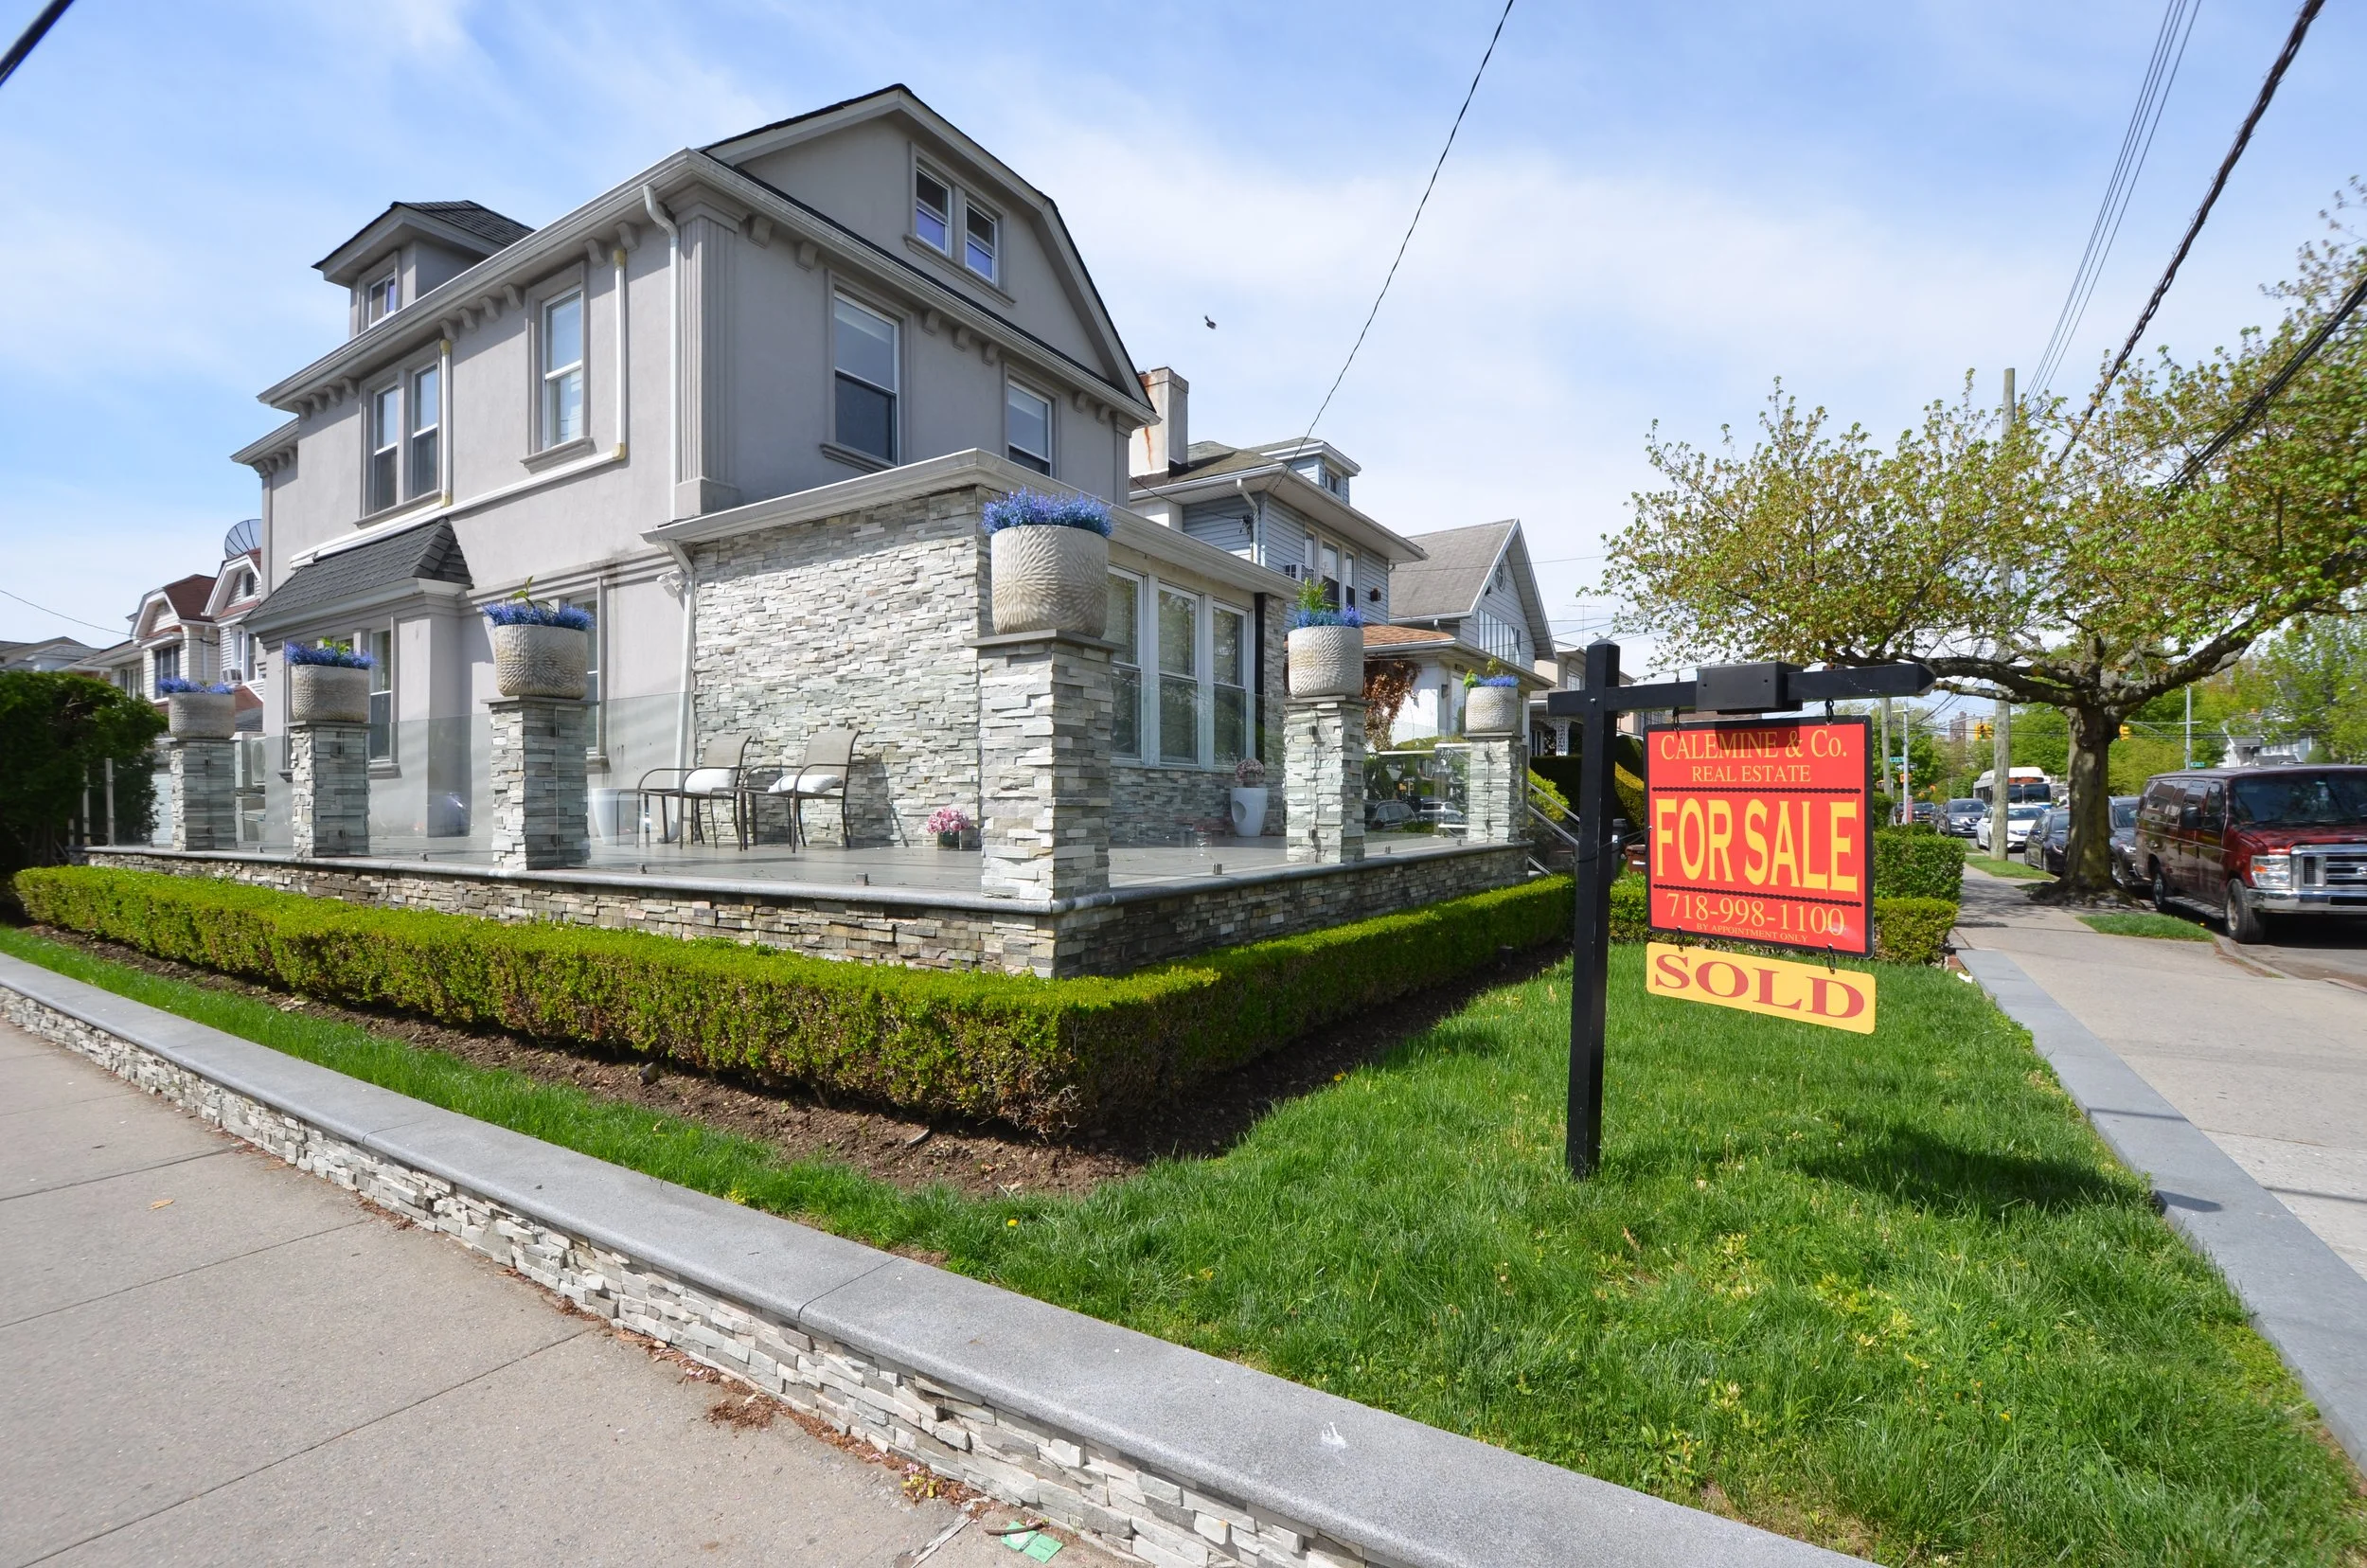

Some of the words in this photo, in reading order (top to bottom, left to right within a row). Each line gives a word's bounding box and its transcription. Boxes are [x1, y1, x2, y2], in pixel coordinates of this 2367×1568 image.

[1661, 731, 1779, 760] CALEMINE
[1785, 730, 1804, 758] &
[1810, 728, 1847, 757] Co.
[1692, 765, 1736, 782] REAL
[1741, 764, 1811, 782] ESTATE
[1655, 796, 1735, 882] FOR
[1744, 799, 1859, 896] SALE
[1666, 893, 1845, 936] 718-998-1100
[1697, 922, 1709, 931] BY
[1712, 924, 1779, 939] APPOINTMENT
[1780, 933, 1808, 943] ONLY
[1655, 953, 1865, 1019] SOLD
